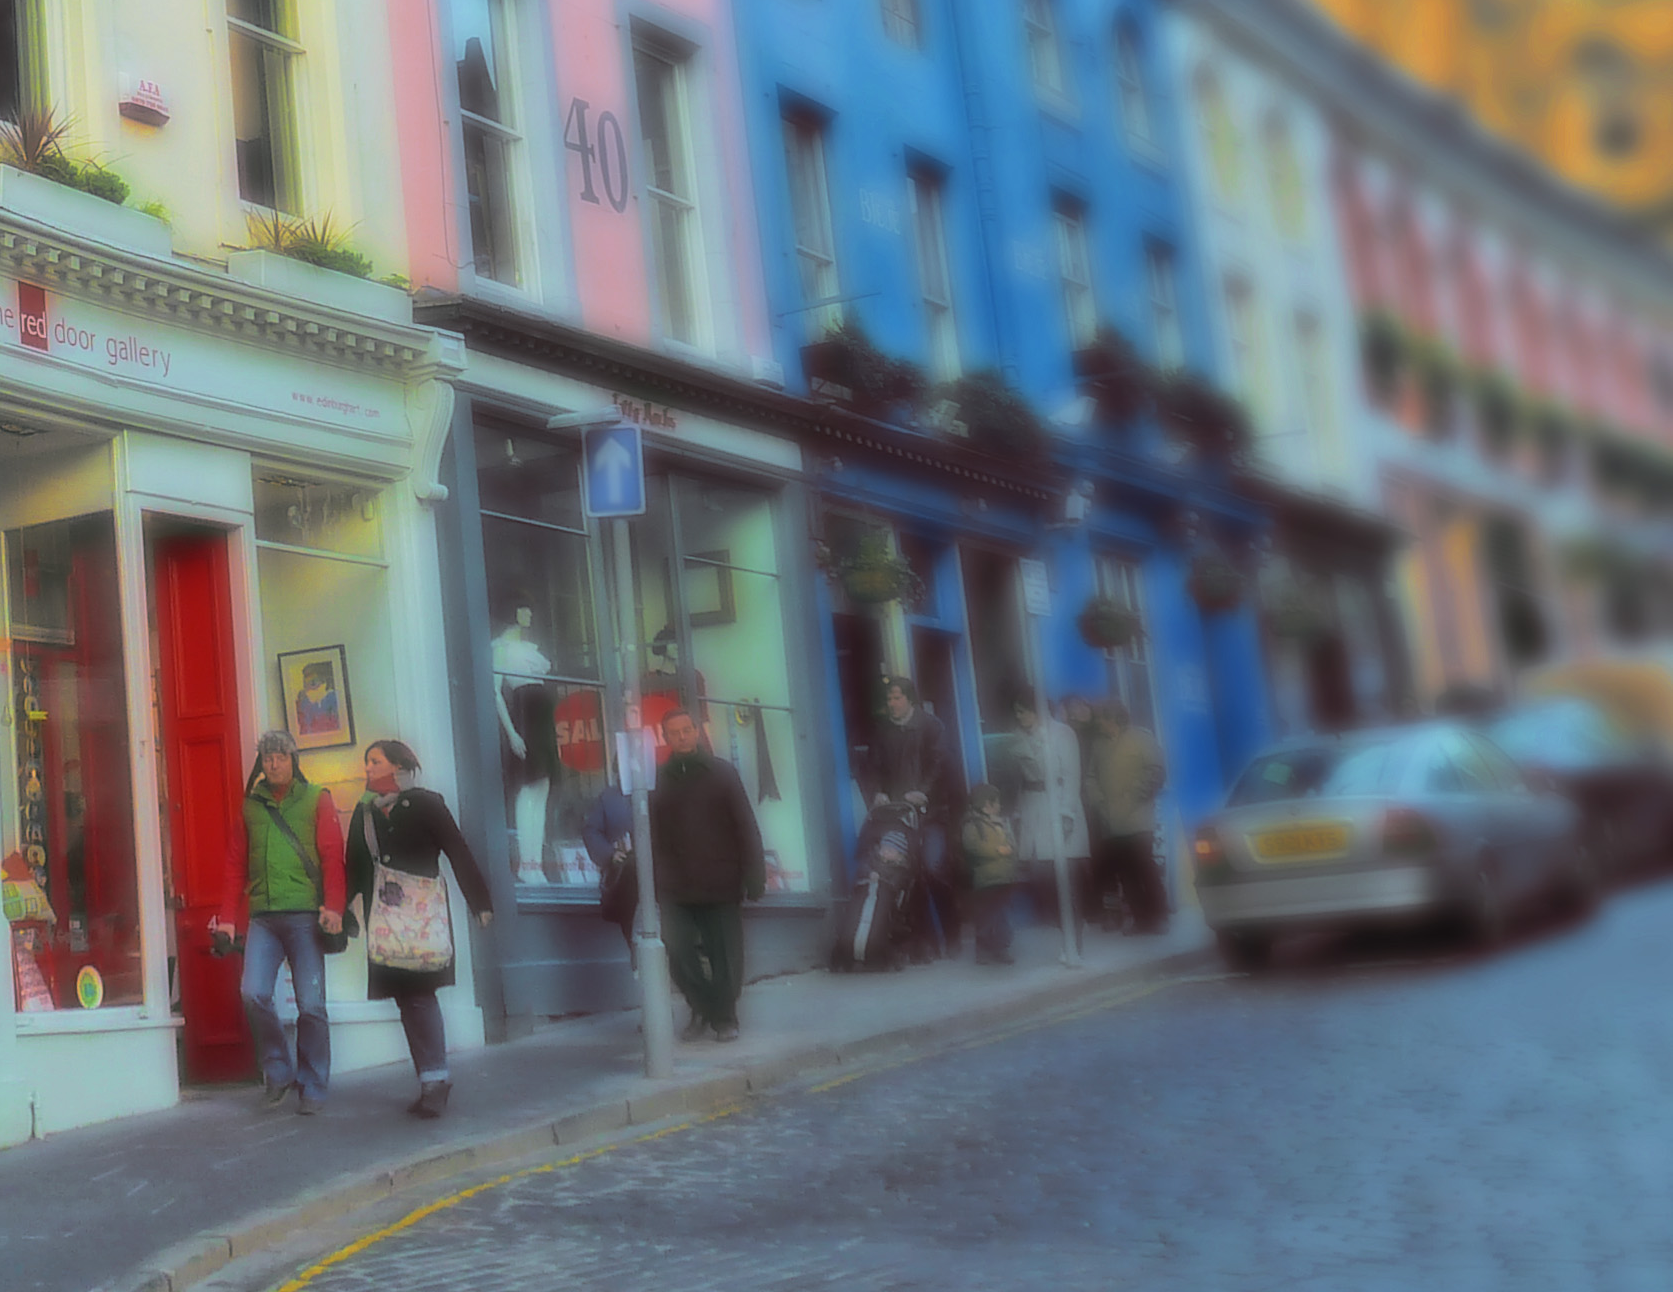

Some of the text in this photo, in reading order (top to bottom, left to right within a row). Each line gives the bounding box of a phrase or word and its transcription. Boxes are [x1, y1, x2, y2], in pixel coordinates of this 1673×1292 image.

[564, 96, 628, 213] 40
[20, 311, 47, 339] red
[54, 317, 96, 351] door
[106, 335, 171, 378] gallery
